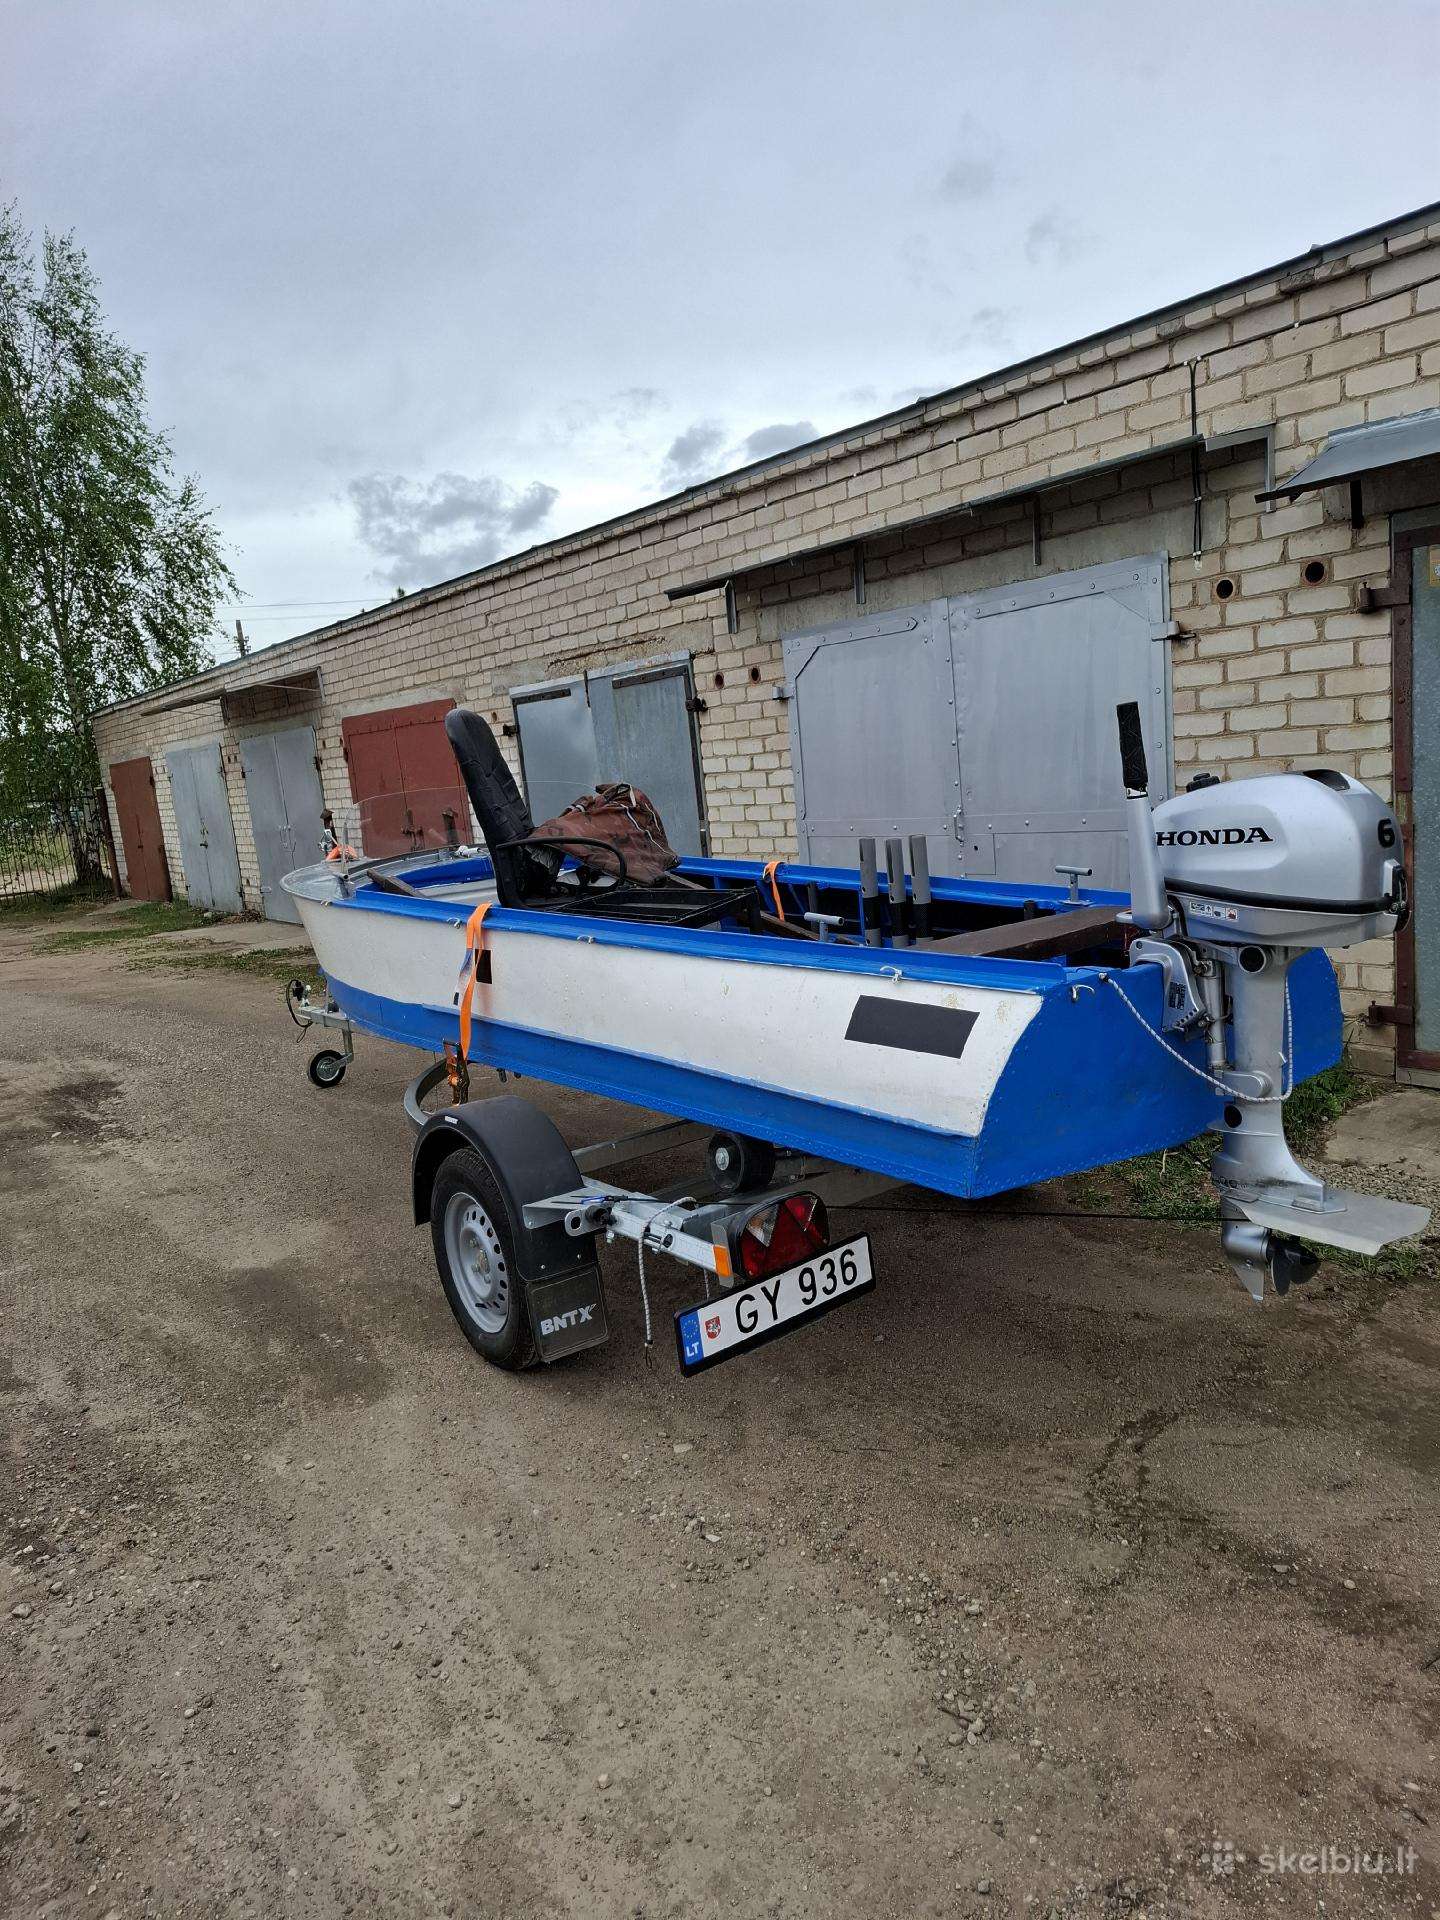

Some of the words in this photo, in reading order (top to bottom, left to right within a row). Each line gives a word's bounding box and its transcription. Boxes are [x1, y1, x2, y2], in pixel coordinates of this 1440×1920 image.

[1156, 827, 1273, 846] HONDA
[1377, 818, 1396, 848] 6
[735, 1280, 783, 1334] GY
[798, 1248, 858, 1306] 936
[540, 1303, 596, 1335] BNTX
[685, 1342, 700, 1358] LT
